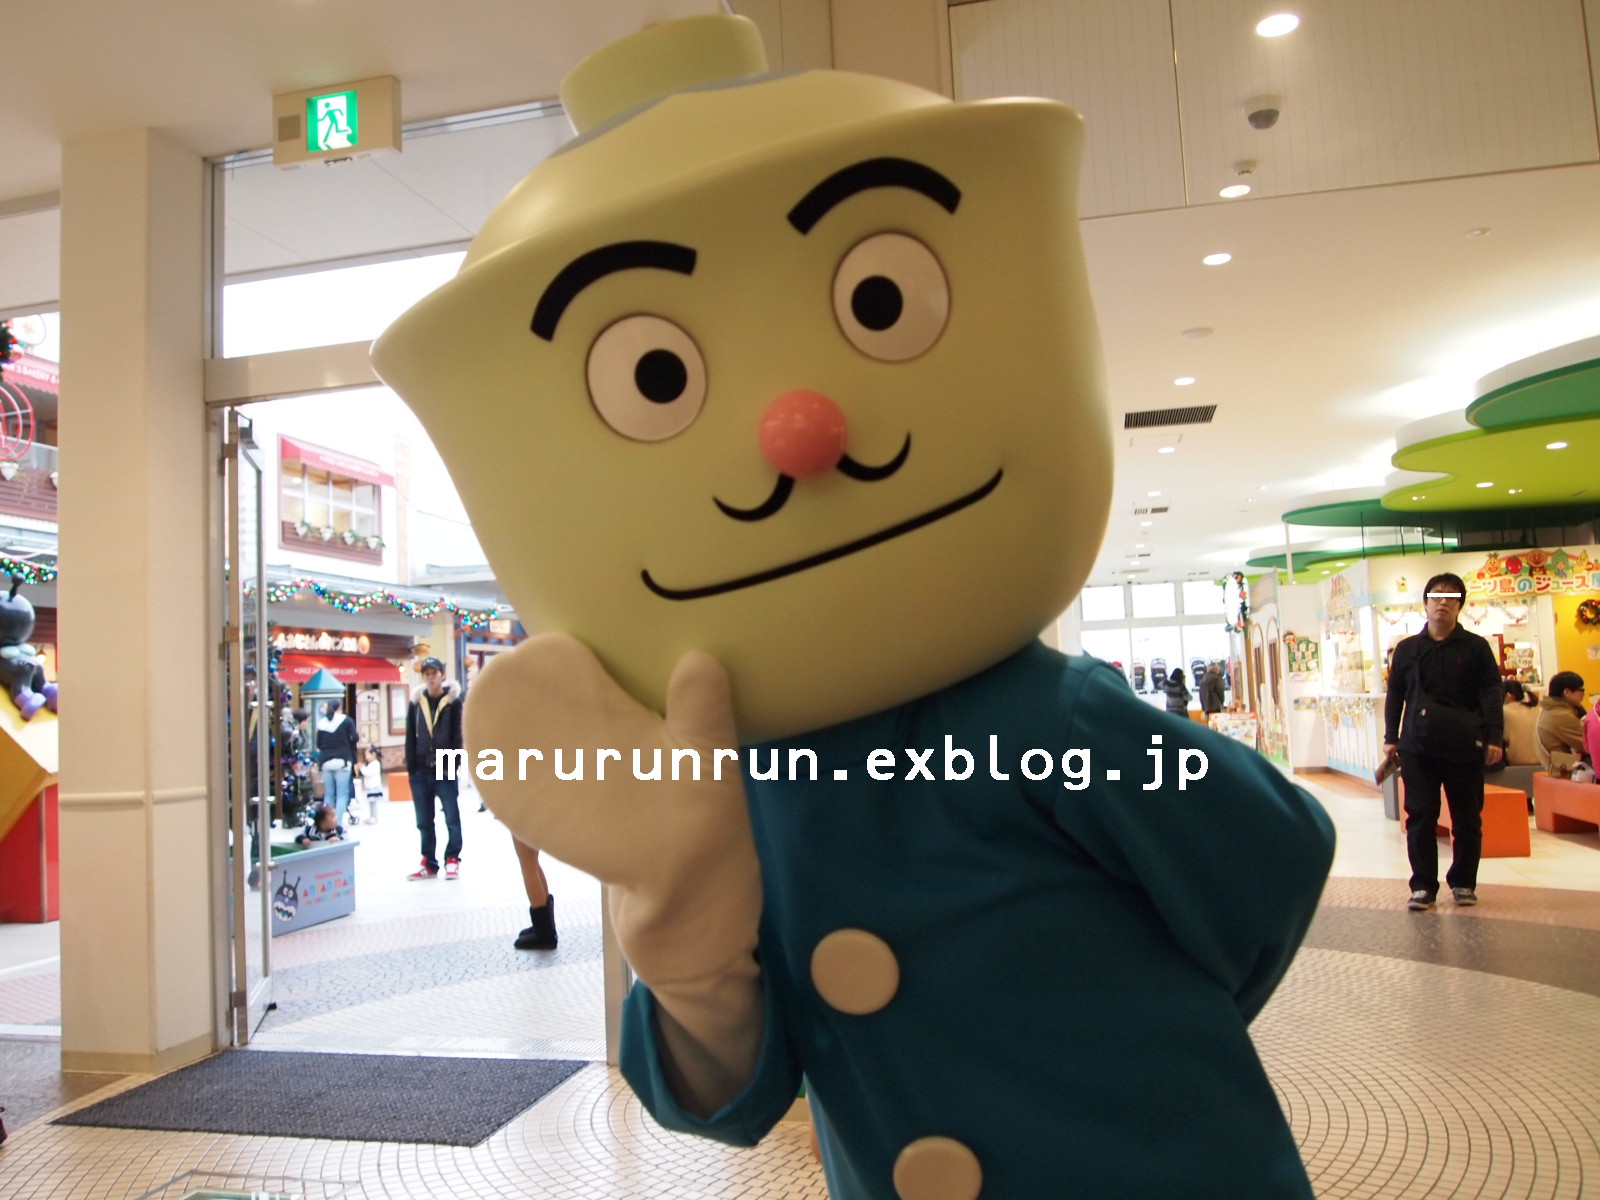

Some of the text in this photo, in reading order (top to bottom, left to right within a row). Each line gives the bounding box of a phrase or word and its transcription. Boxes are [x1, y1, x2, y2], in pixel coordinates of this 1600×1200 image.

[1467, 572, 1600, 594] ーツ島のジュース
